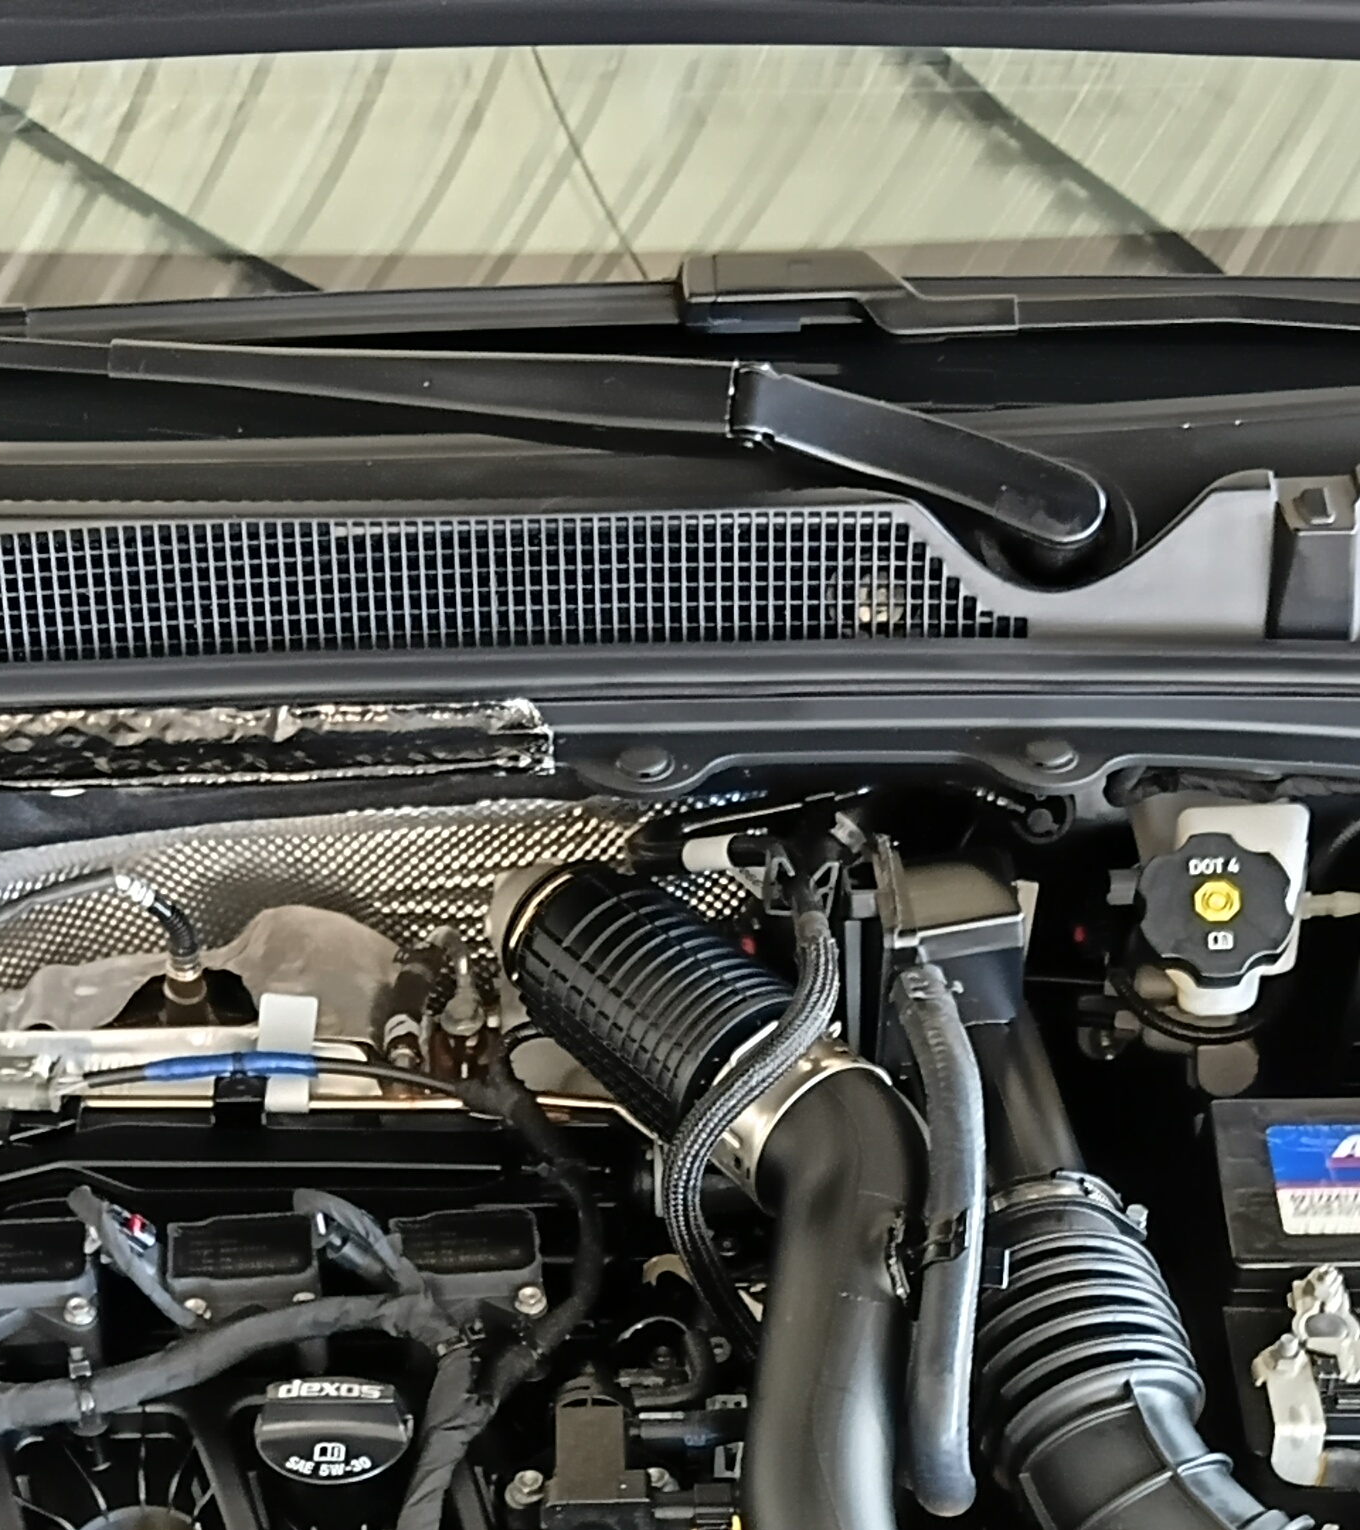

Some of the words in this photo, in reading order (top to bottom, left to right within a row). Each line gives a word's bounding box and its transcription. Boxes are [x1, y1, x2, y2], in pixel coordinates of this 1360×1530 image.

[1188, 857, 1225, 876] DOT
[1227, 856, 1241, 874] 4
[277, 1378, 385, 1399] dexos
[285, 1455, 315, 1475] SAE
[318, 1456, 373, 1477] 5W-30
